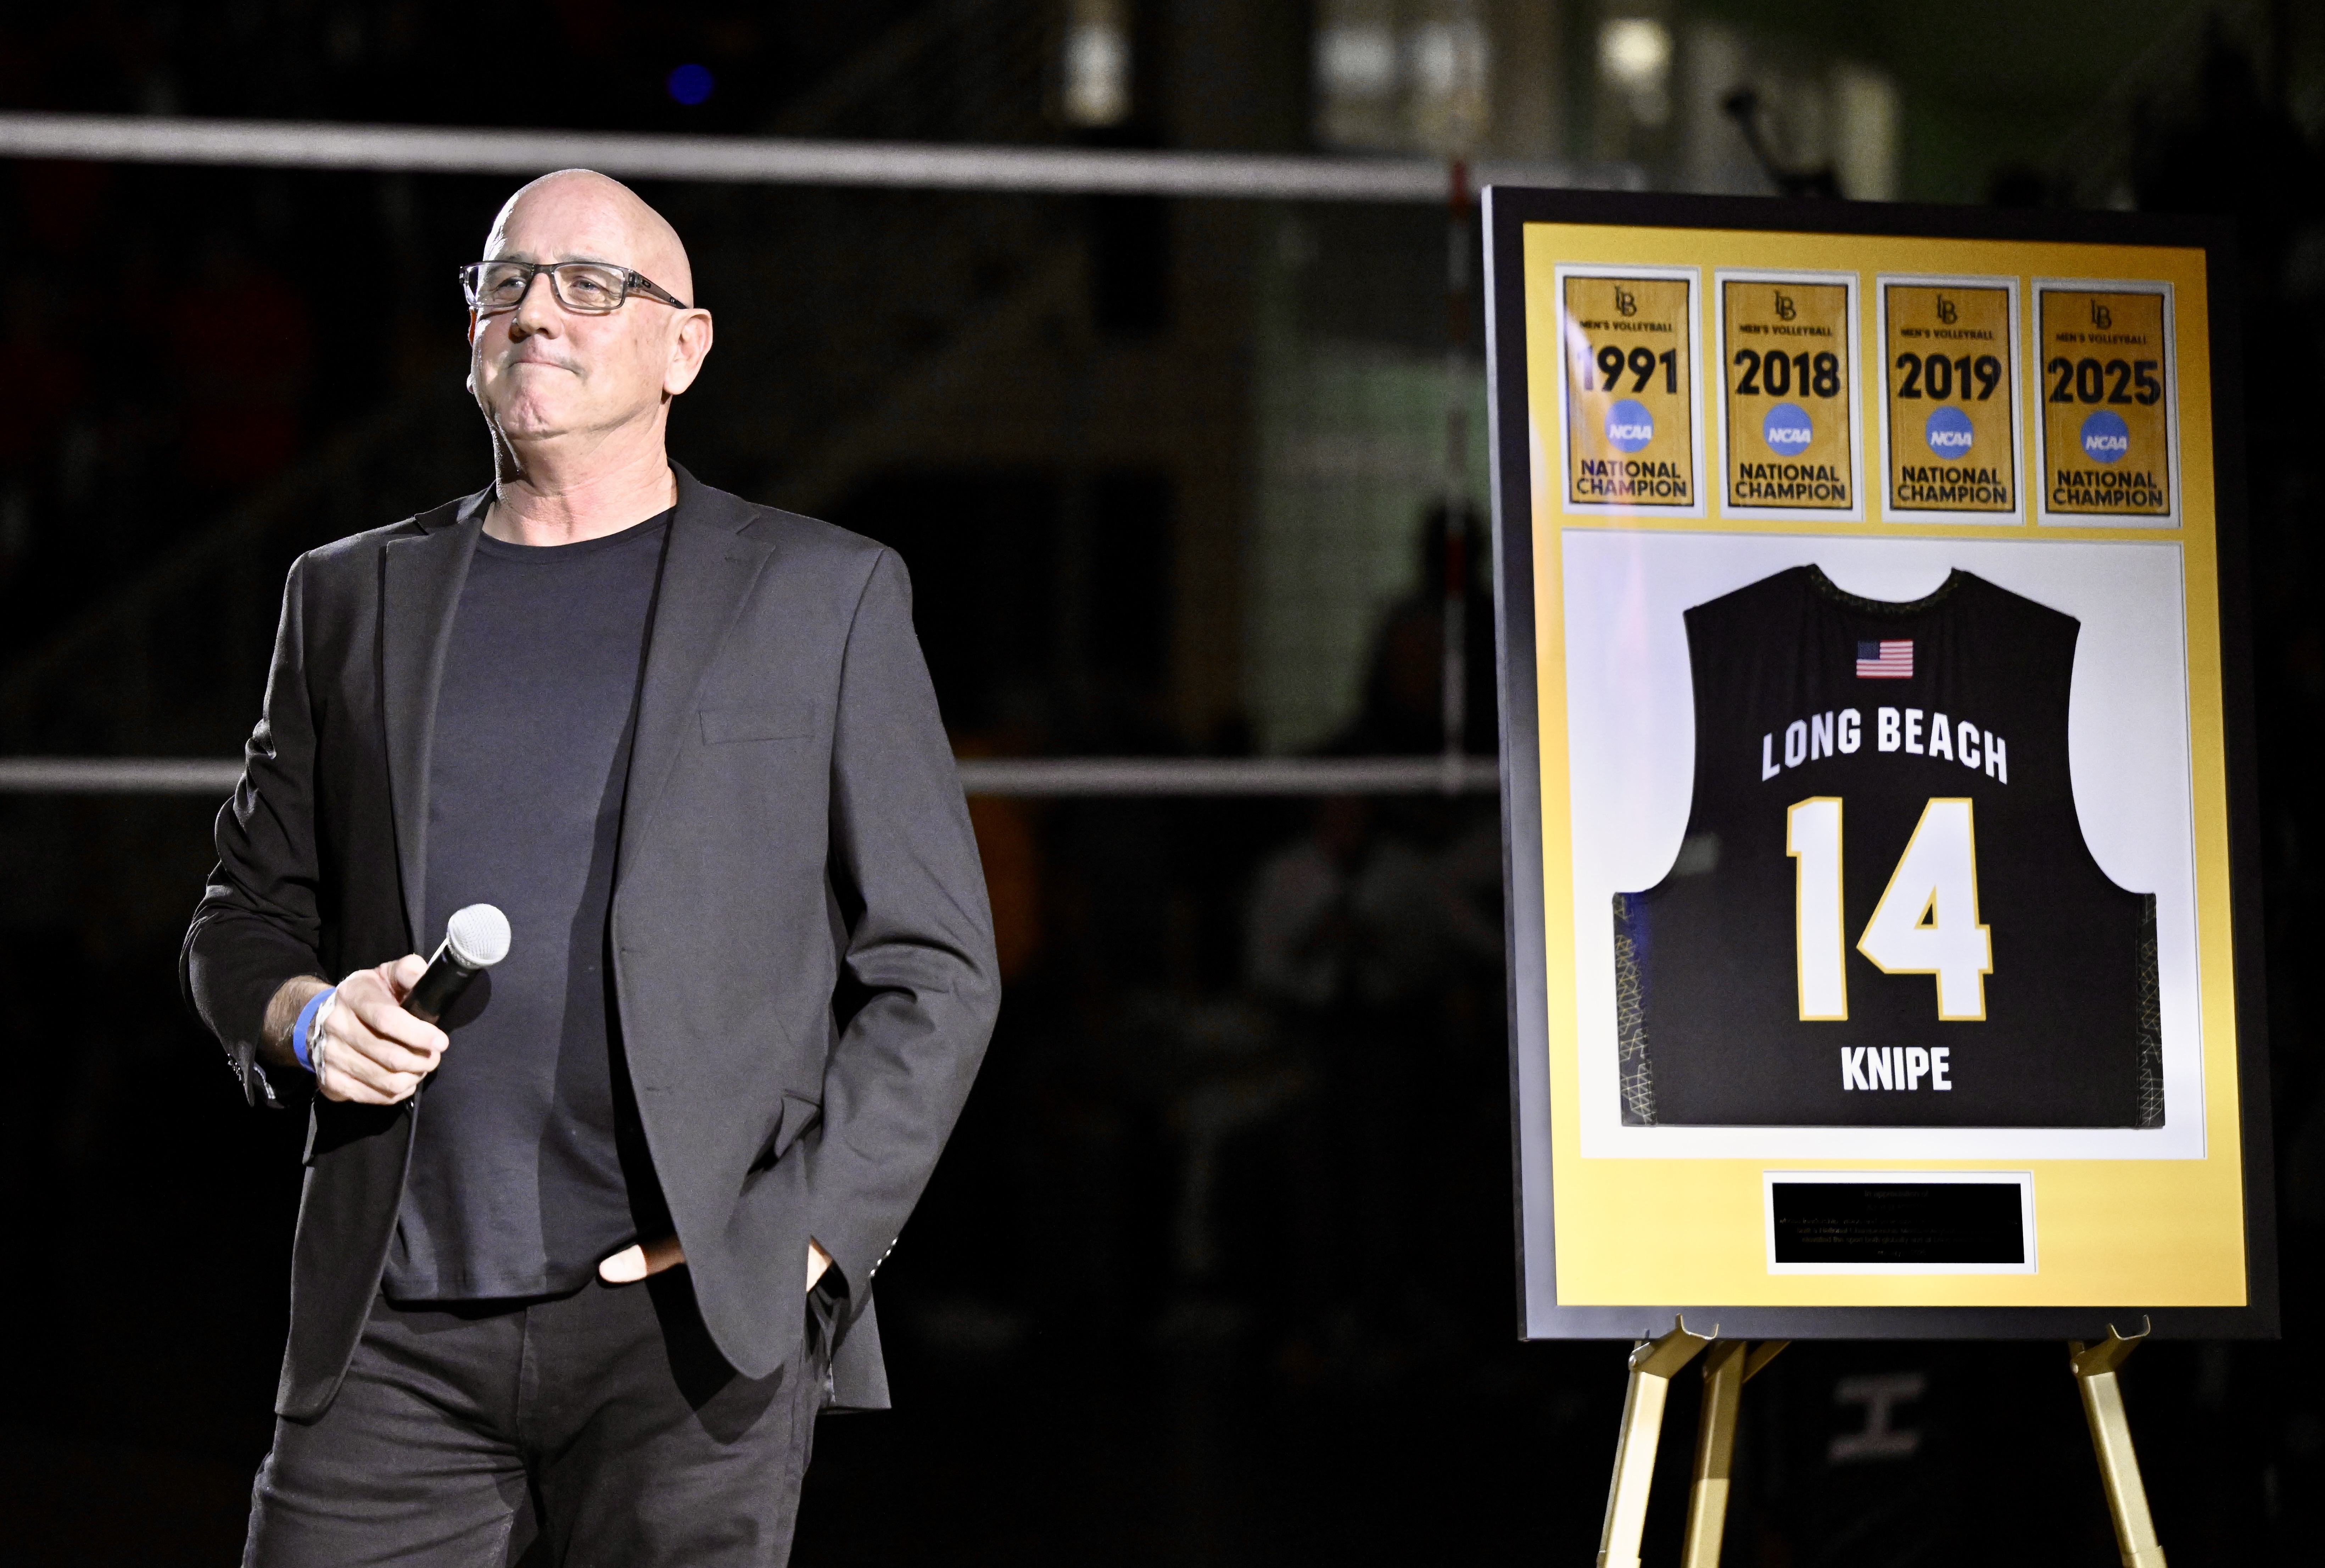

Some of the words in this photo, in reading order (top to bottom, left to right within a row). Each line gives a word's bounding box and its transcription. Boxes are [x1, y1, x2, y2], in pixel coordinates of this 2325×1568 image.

[1580, 320, 1608, 330] MEN'S
[1613, 321, 1672, 332] VOLLEYBALL
[1740, 324, 1768, 334] MEN'S
[1773, 325, 1832, 337] VOLLEYBALL
[1901, 329, 1930, 338] MEN'S
[1934, 329, 1994, 341] VOLLEYBALL
[2056, 333, 2085, 343] MEN'S
[2088, 334, 2147, 345] VOLLEYBALL
[1577, 346, 1677, 394] 1991
[1734, 349, 1841, 398] 2018
[1896, 353, 2002, 401] 2019
[2048, 357, 2161, 406] 2025
[1609, 425, 1652, 440] NCAA
[1768, 428, 1811, 443] NCAA
[1931, 431, 1972, 447] NCAA
[2086, 435, 2127, 451] NCAA
[1581, 459, 1681, 478] NATIONAL
[1740, 463, 1840, 482] NATIONAL
[1902, 465, 2001, 485] NATIONAL
[1577, 478, 1686, 497] CHAMPION
[2058, 470, 2157, 489] NATIONAL
[1735, 481, 1845, 502] CHAMPION
[1898, 485, 2007, 504] CHAMPION
[2053, 488, 2163, 508] CHAMPION
[1762, 708, 1861, 781] LONG
[1878, 707, 2007, 785] BEACH
[1787, 796, 1993, 1021] 14
[1841, 1047, 1952, 1090] KNIPE
